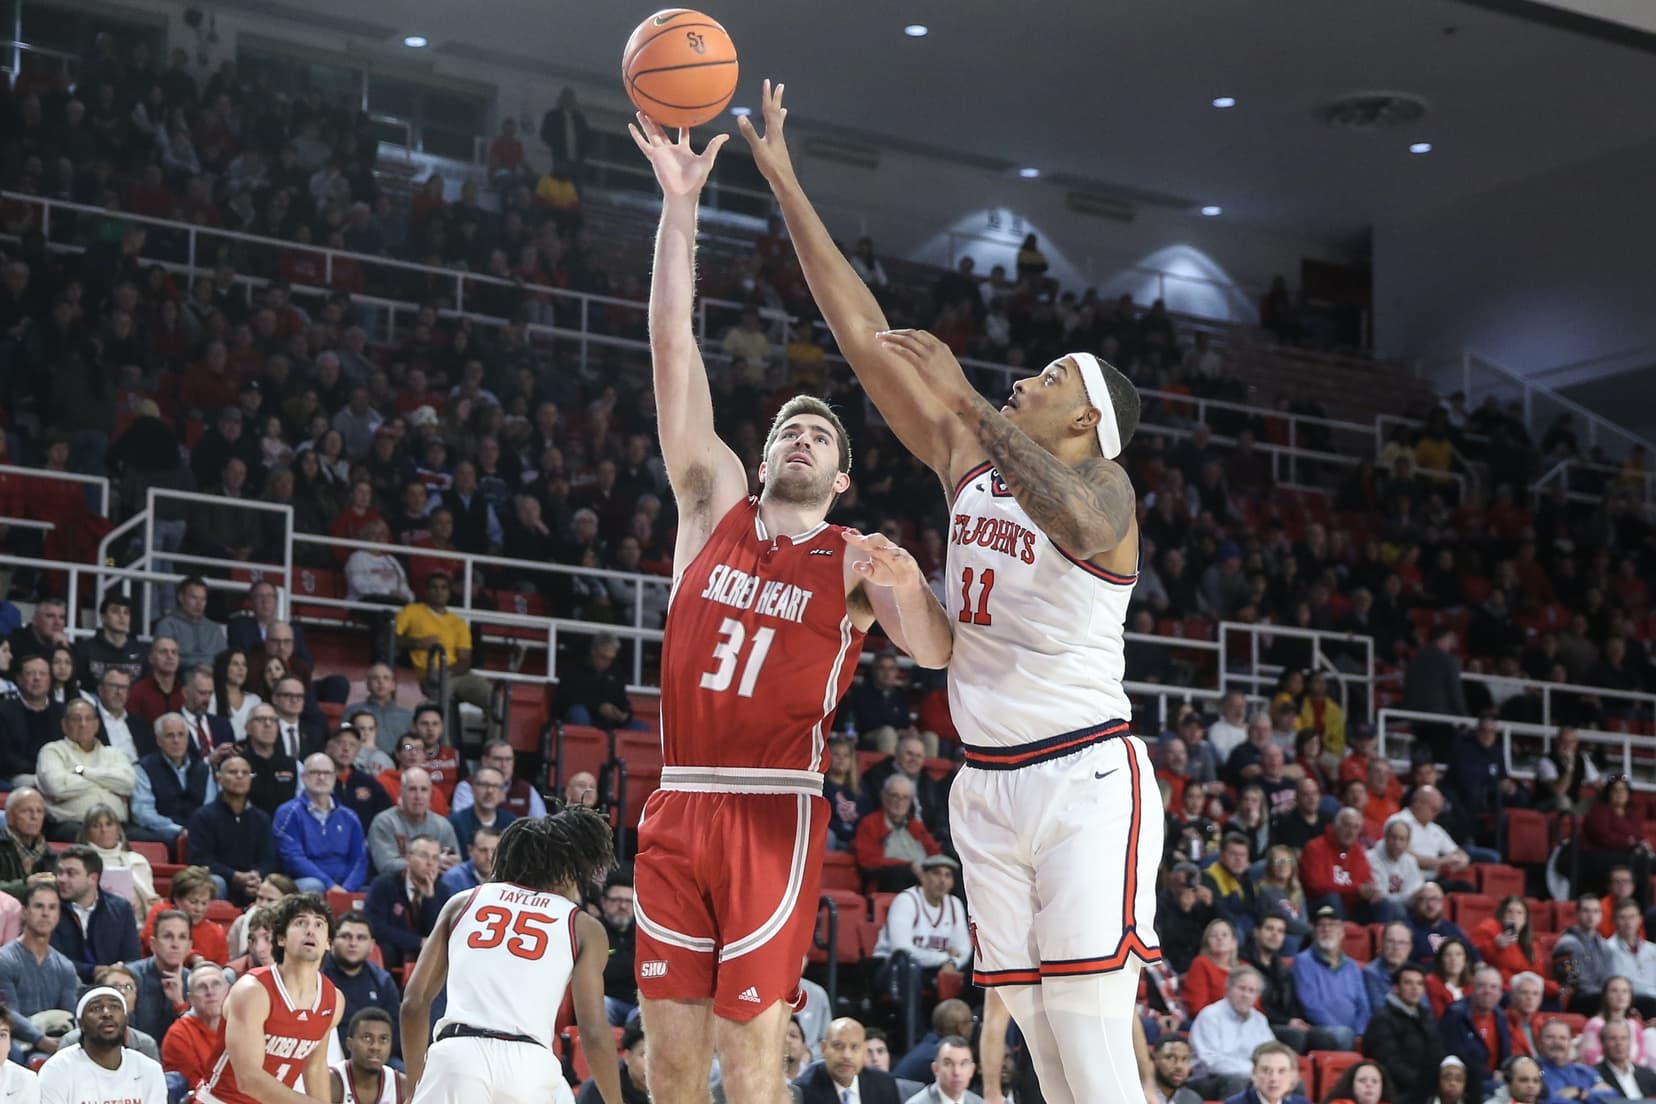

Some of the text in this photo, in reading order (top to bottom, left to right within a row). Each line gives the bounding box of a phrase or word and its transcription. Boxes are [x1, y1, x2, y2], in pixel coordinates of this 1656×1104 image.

[754, 580, 814, 624] HEART
[958, 566, 995, 626] 11
[699, 616, 777, 698] 31
[498, 888, 552, 909] TAYLOR
[467, 904, 560, 961] 35
[641, 961, 667, 977] SHU
